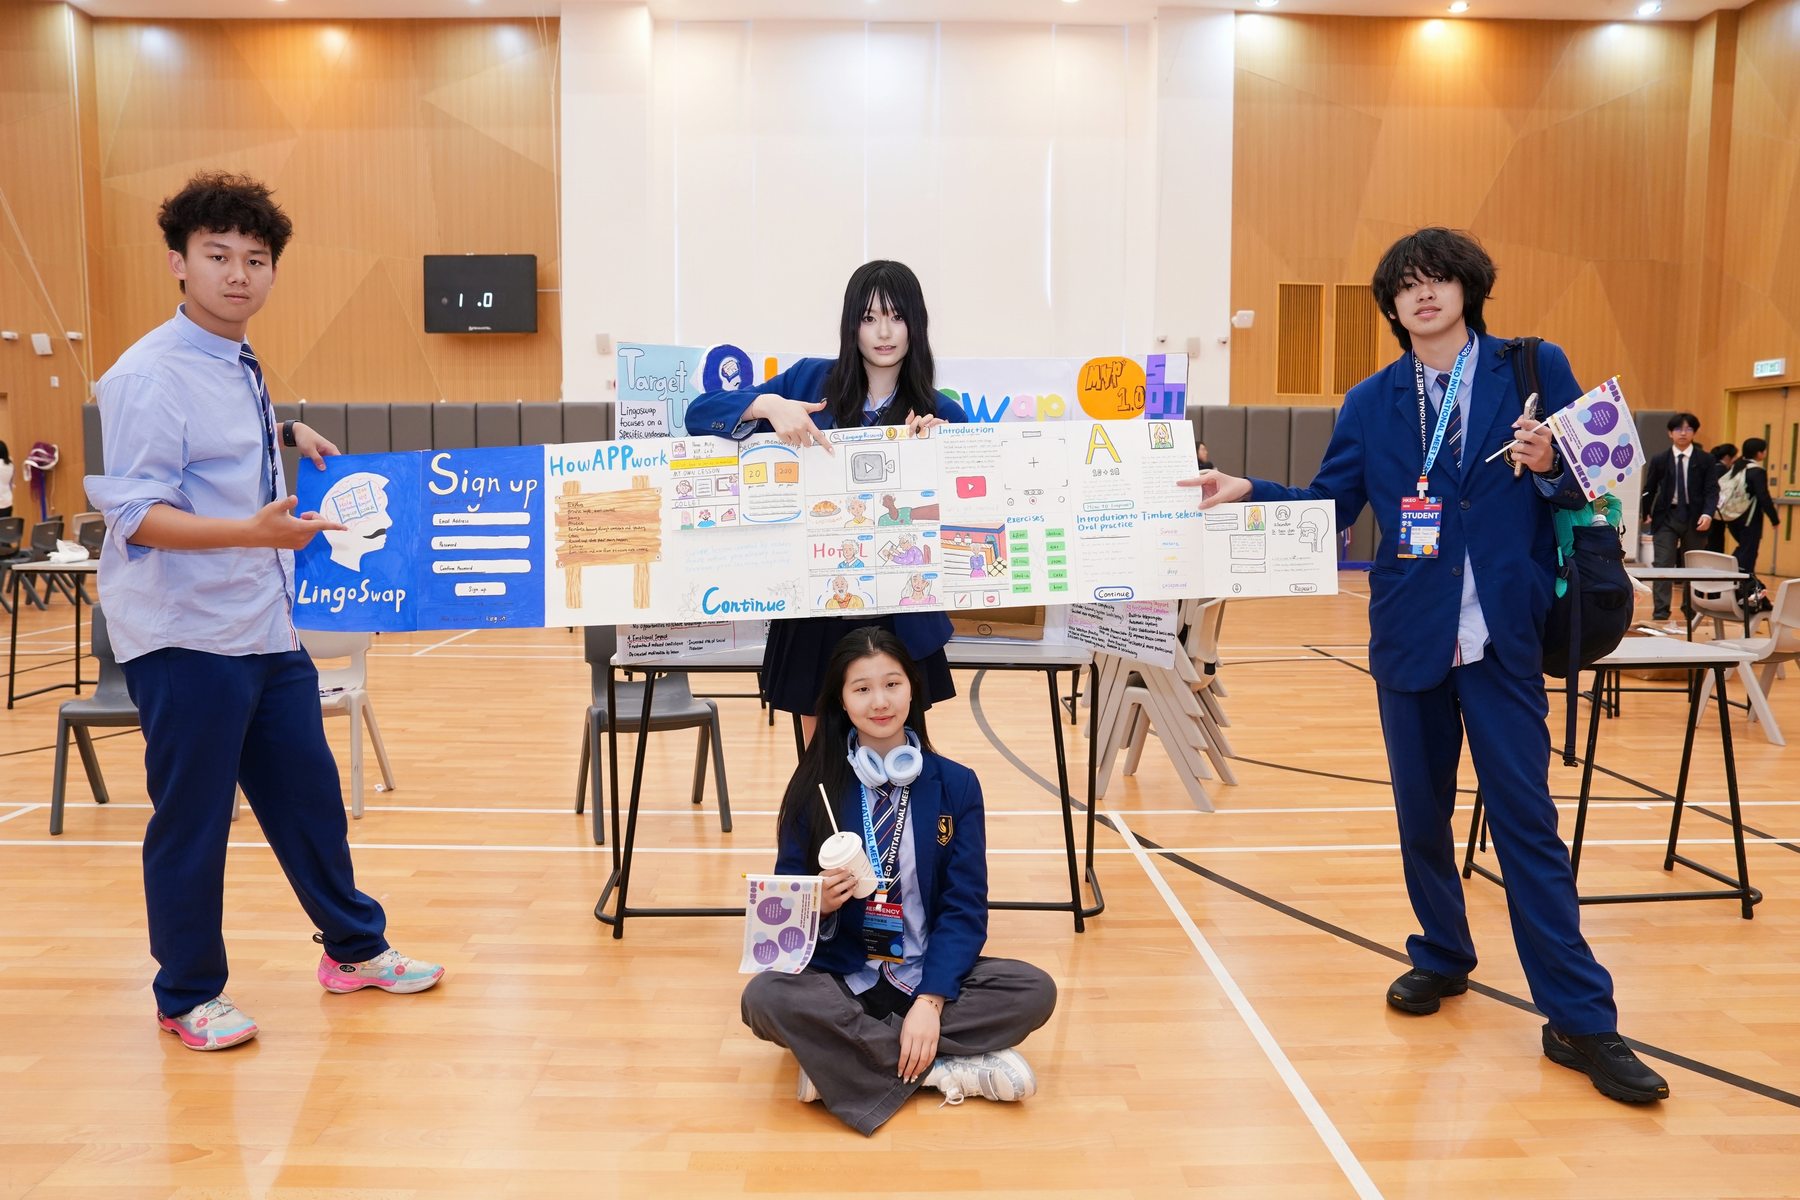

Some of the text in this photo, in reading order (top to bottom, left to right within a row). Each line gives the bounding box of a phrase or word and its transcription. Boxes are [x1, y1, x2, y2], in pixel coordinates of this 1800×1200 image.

[618, 347, 687, 401] Target
[1085, 361, 1125, 391] MVP
[1453, 355, 1465, 378] HKEO
[1416, 373, 1425, 395] MEET
[1117, 385, 1146, 412] 1.0
[1437, 378, 1460, 433] INVITATIONAL
[620, 418, 645, 427] focuses
[939, 426, 994, 435] Introduction
[619, 429, 643, 440] Specific
[1085, 424, 1122, 465] A
[1429, 434, 1440, 455] MEET
[428, 453, 501, 512] Sign
[510, 479, 537, 508] up
[749, 470, 761, 478] 20
[1007, 515, 1045, 523] exercises
[1078, 521, 1133, 531] Oral practice
[1141, 510, 1173, 520] Timbre
[297, 578, 406, 613] LingoSwap
[702, 586, 786, 615] Continue
[1098, 590, 1130, 599] Continue
[654, 633, 668, 641] Impact
[887, 807, 906, 864] INVITATIONAL
[869, 845, 880, 868] MEET
